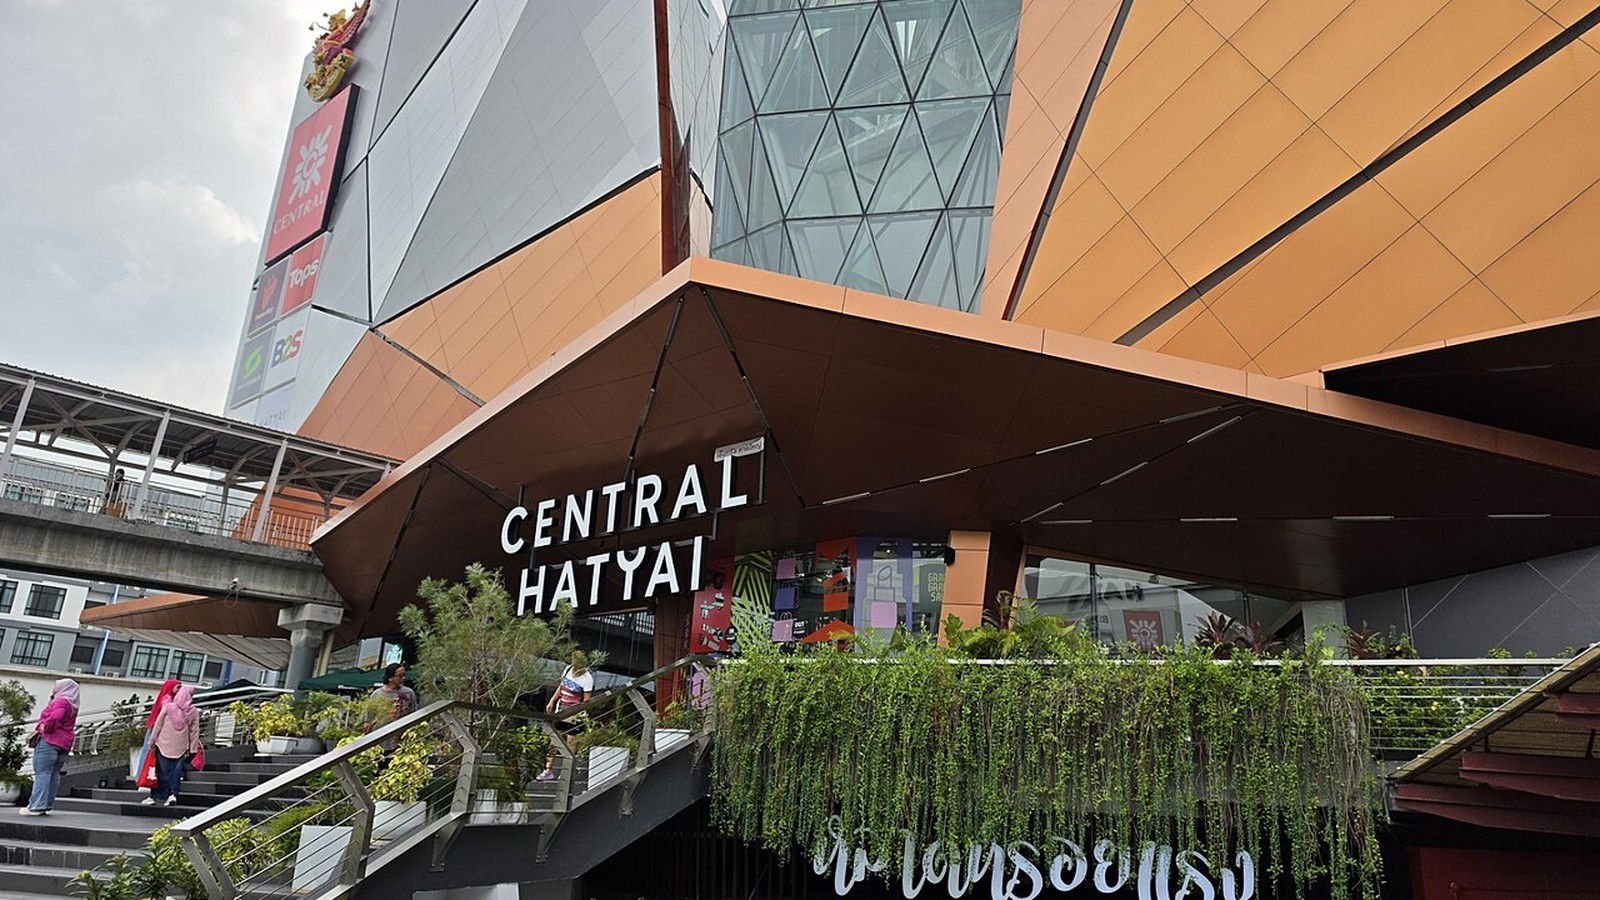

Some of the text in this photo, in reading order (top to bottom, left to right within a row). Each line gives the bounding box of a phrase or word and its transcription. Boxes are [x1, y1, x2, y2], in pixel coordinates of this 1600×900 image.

[273, 190, 325, 235] CENTRAL
[289, 259, 320, 288] Tops
[271, 329, 304, 368] B2S
[500, 453, 748, 555] CENTRAL
[516, 535, 703, 617] HATYAI
